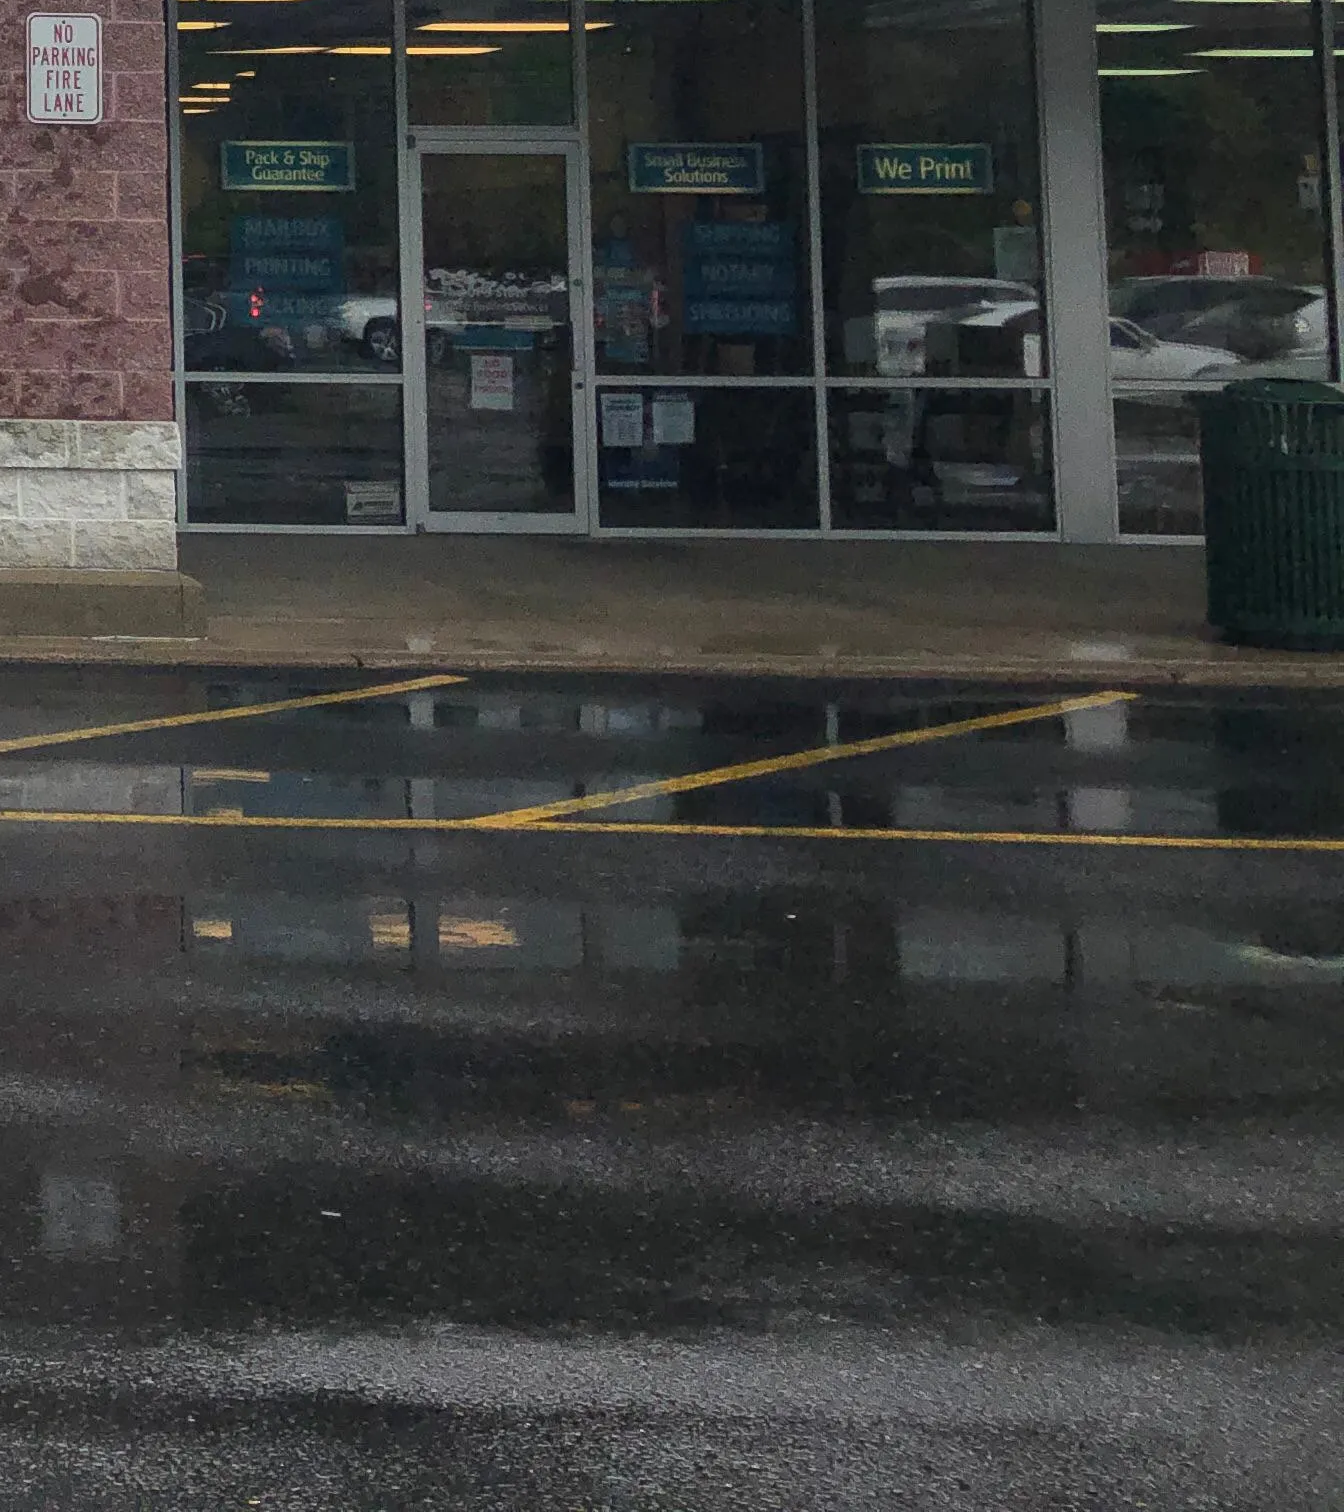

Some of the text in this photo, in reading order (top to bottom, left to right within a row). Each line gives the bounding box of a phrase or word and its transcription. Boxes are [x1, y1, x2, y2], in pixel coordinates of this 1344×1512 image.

[53, 23, 74, 44] NO
[32, 46, 96, 67] PARKING
[45, 70, 82, 90] FIRE
[43, 92, 85, 113] LANE
[245, 150, 330, 169] Pack & Ship
[873, 156, 974, 180] We Print
[251, 166, 325, 182] Guarantee
[663, 167, 729, 184] Solutions
